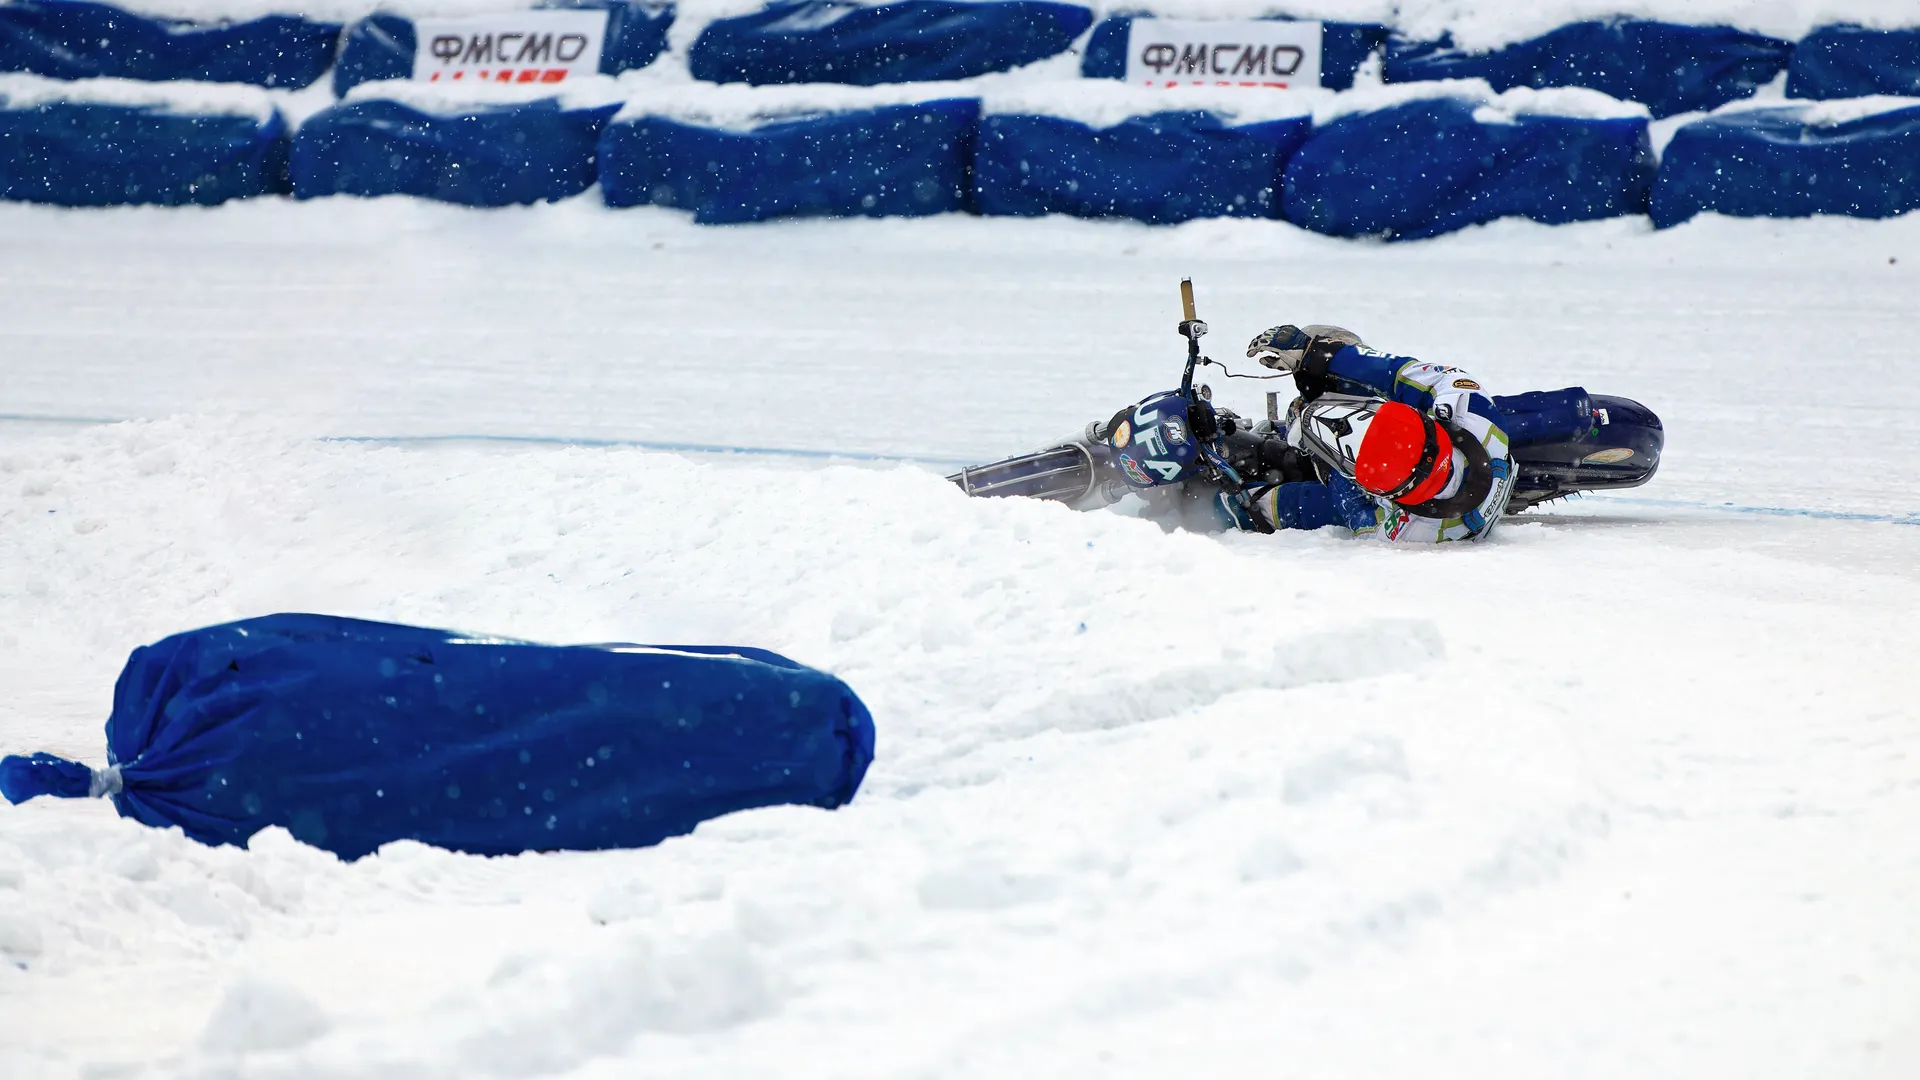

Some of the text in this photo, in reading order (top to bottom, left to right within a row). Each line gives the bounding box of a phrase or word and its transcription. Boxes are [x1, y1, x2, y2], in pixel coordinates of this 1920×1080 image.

[431, 32, 588, 64] ФМСМО
[1141, 43, 1305, 76] ФМСМО
[1134, 395, 1183, 481] UFA
